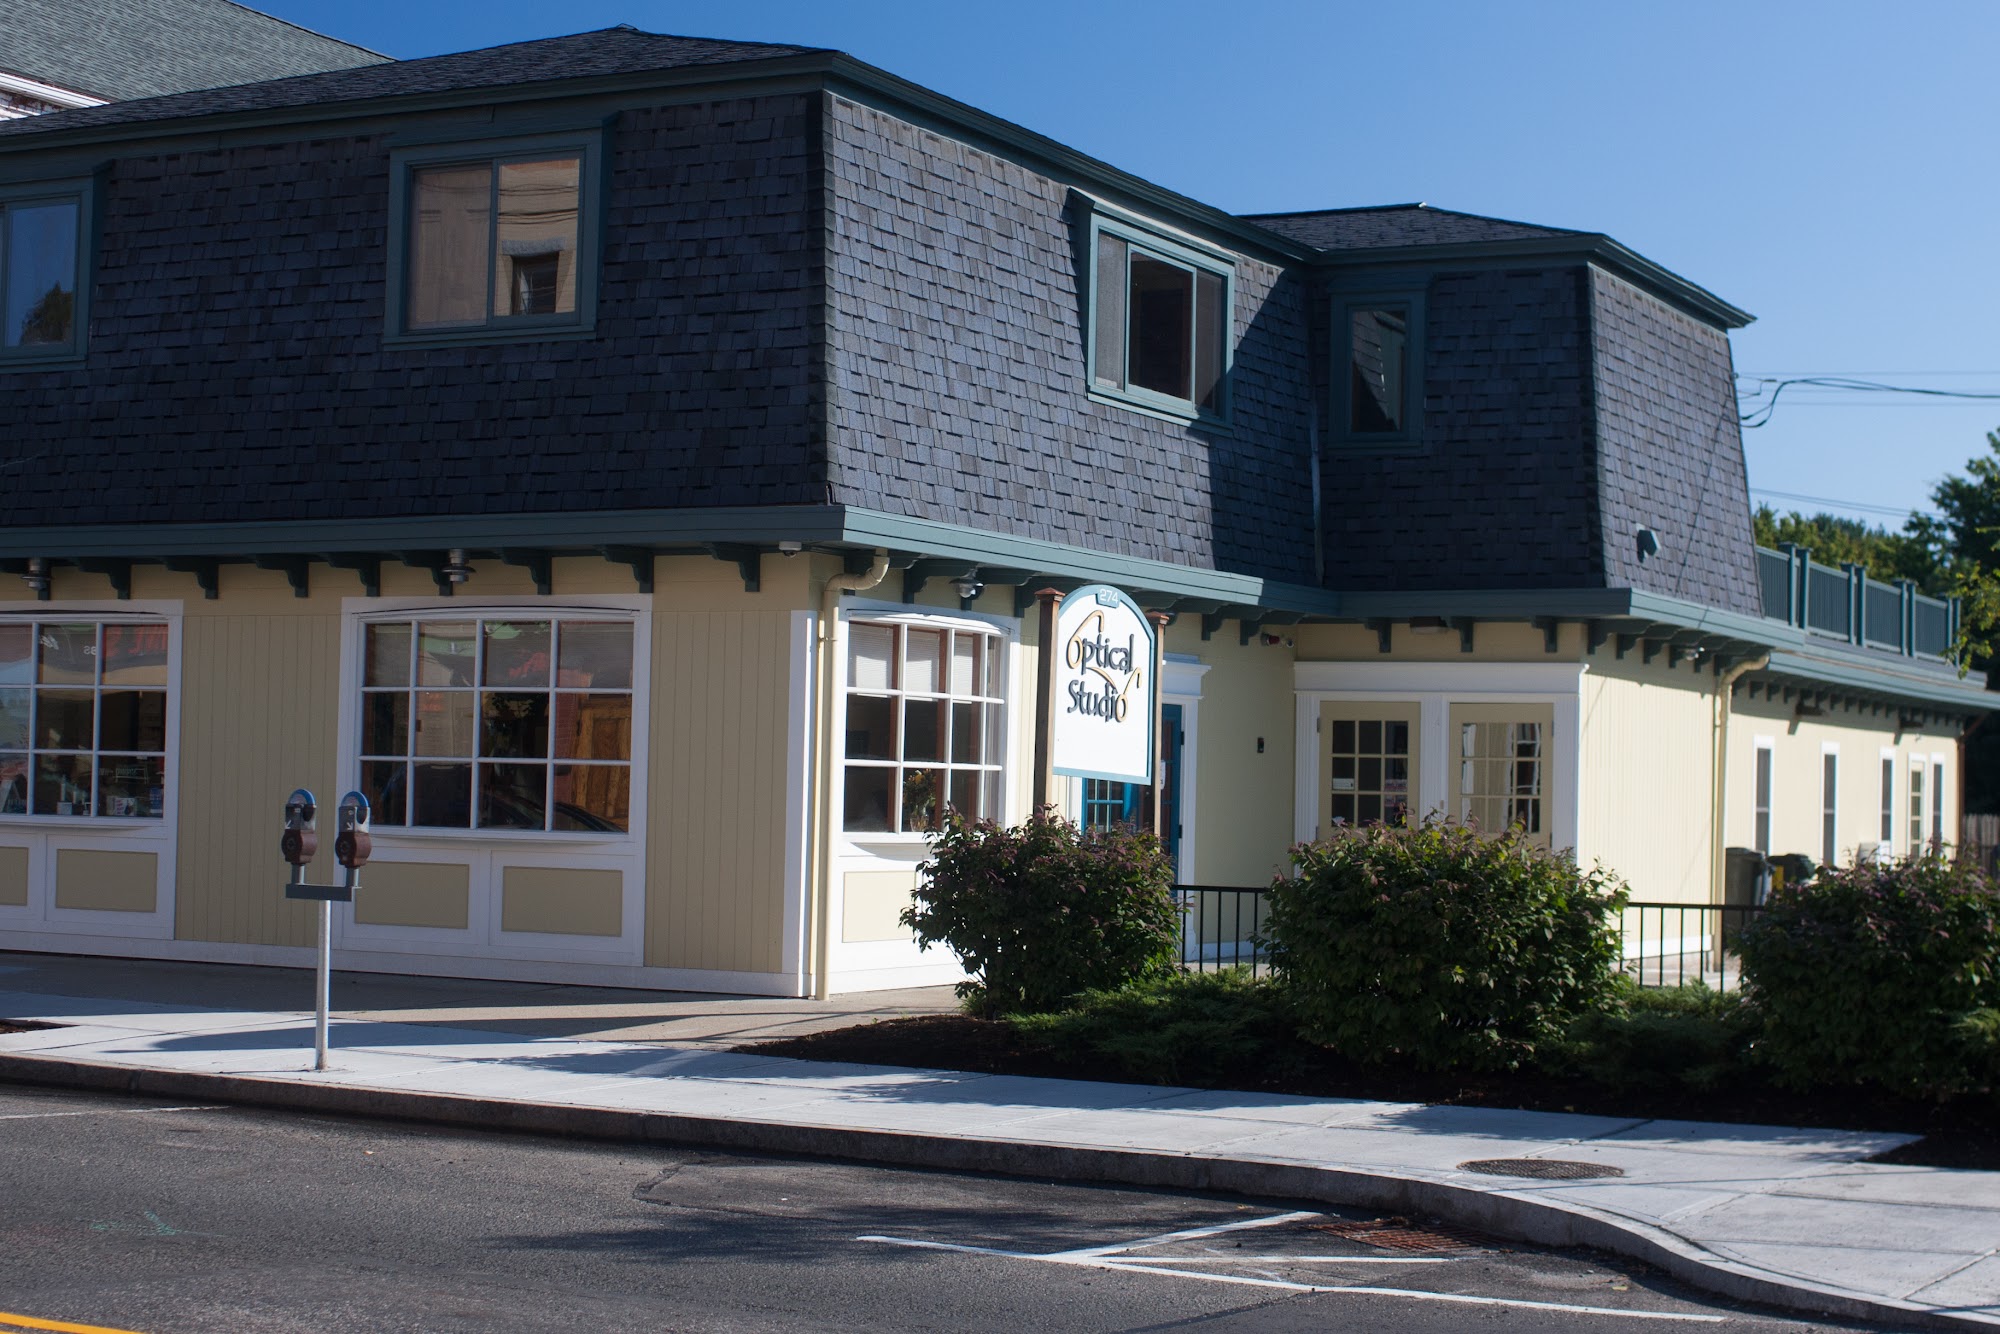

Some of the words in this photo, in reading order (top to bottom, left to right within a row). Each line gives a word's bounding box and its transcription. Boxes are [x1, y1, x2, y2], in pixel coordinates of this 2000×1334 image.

[1099, 588, 1119, 604] 274
[1066, 620, 1135, 675] Optical
[1066, 678, 1130, 723] Studio
